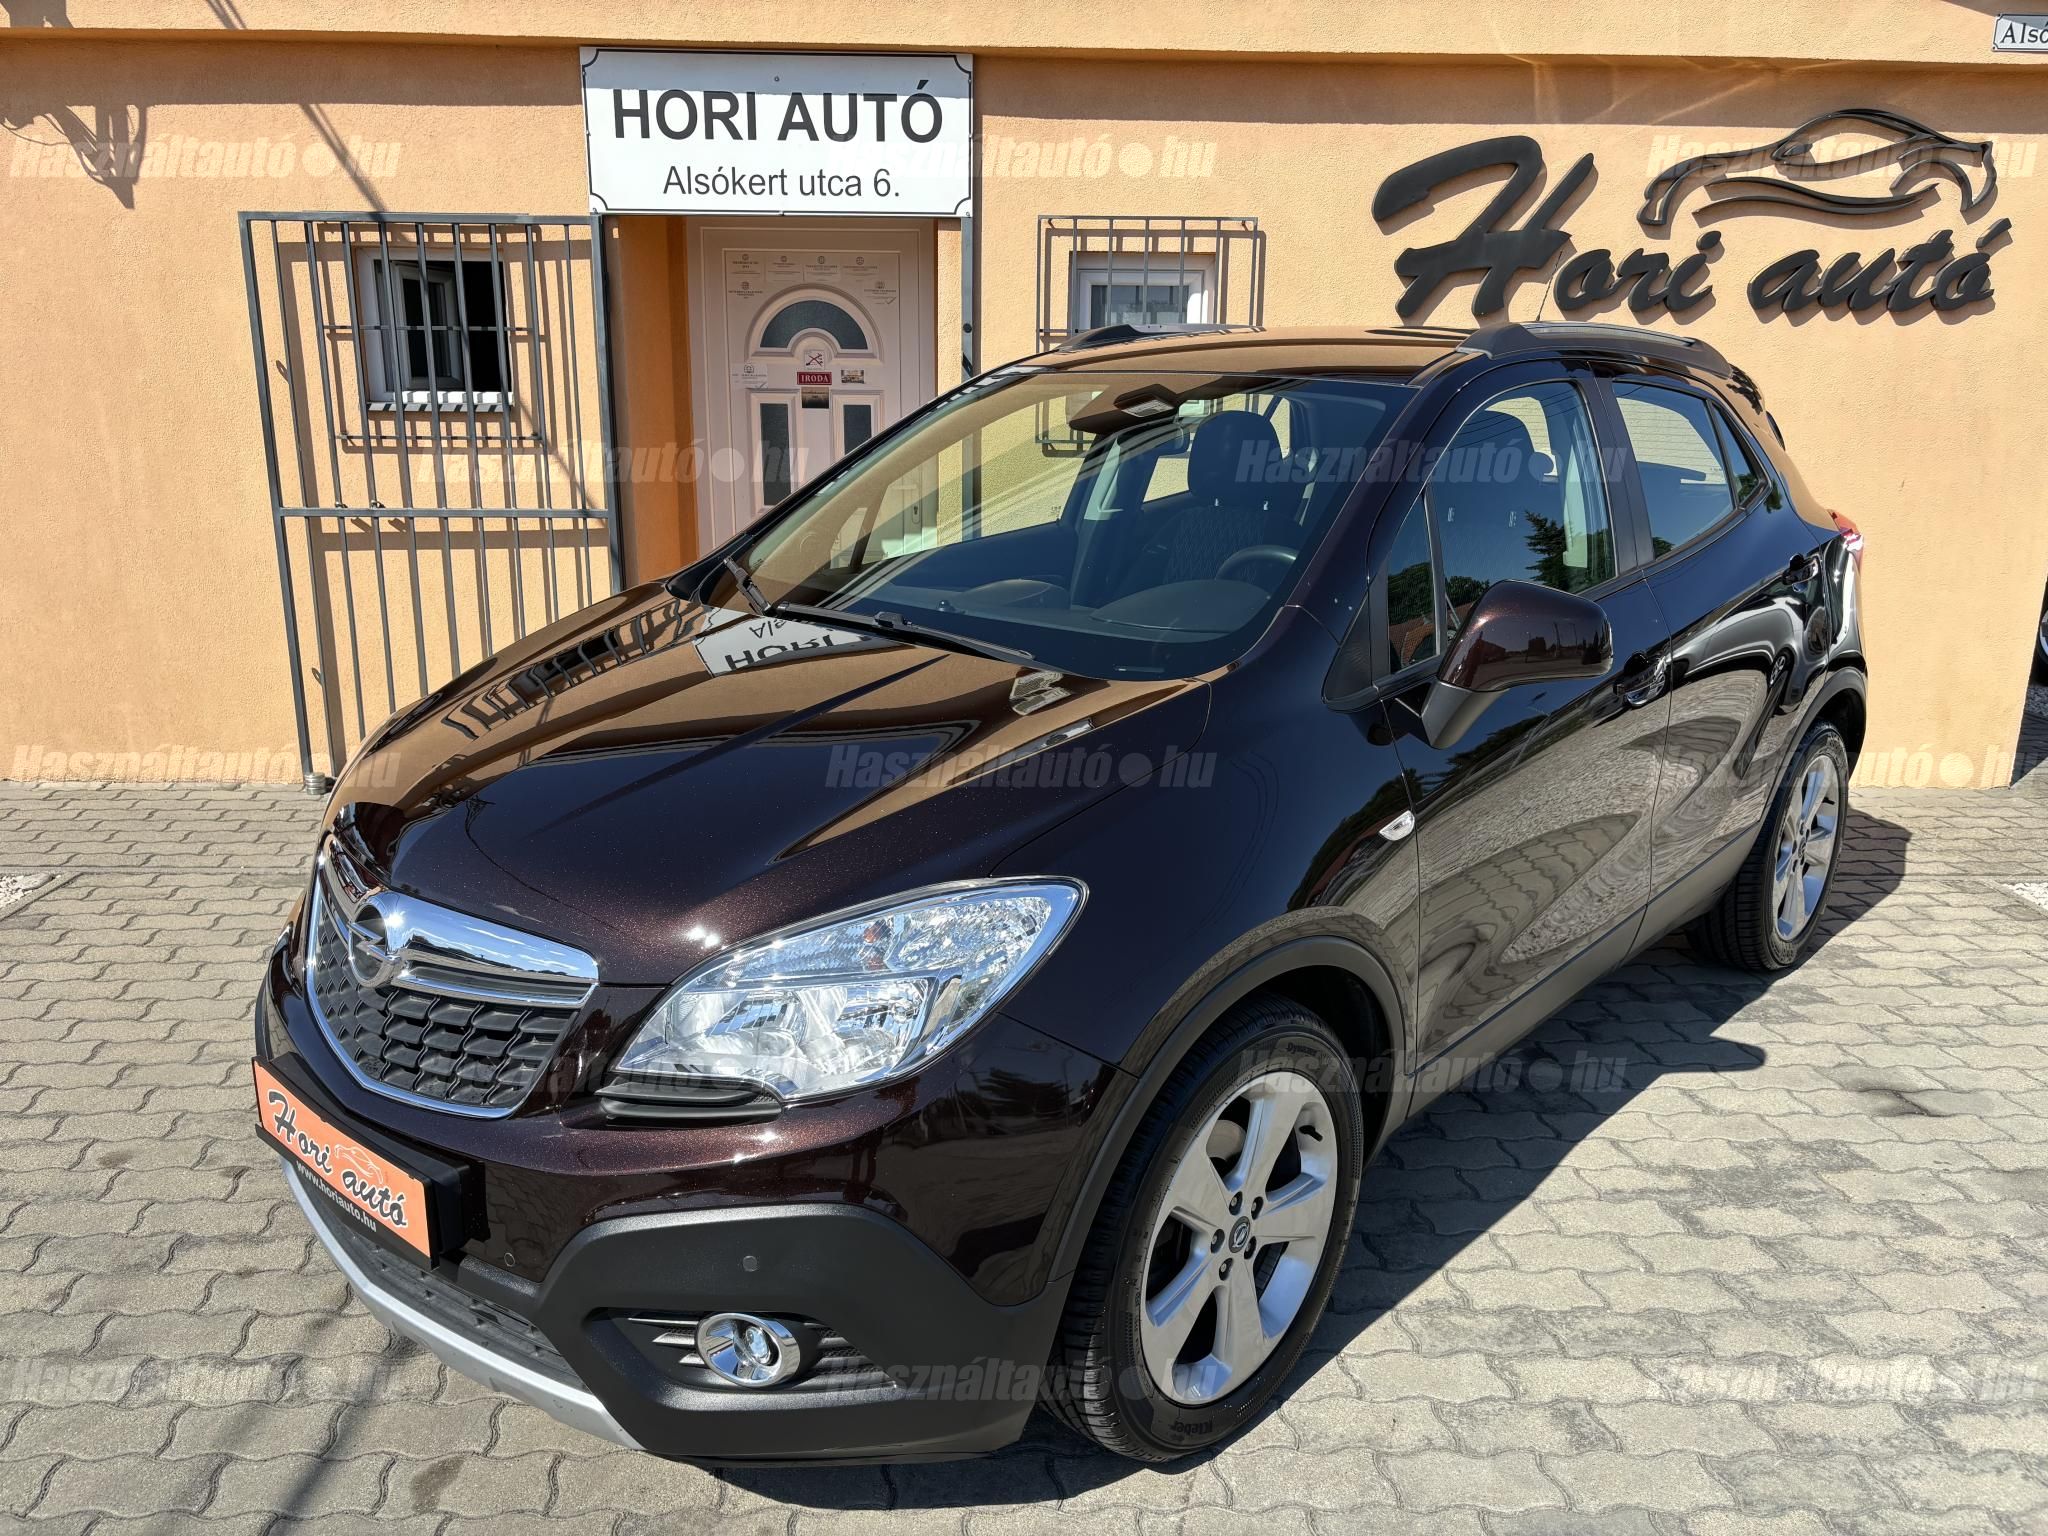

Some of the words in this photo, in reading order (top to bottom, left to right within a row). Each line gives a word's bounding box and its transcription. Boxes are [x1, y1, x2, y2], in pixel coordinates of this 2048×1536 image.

[613, 89, 757, 141] HORI
[777, 79, 942, 143] AUTÓ
[663, 166, 787, 196] Alsókert
[799, 170, 861, 197] utca
[873, 168, 900, 197] 6.
[1371, 135, 1722, 316] Hori
[1748, 218, 2012, 312] autó
[800, 374, 829, 384] IRODA
[267, 1090, 332, 1174] Hori
[341, 1170, 407, 1227] autó
[295, 1160, 377, 1232] www.horiauto.hu
